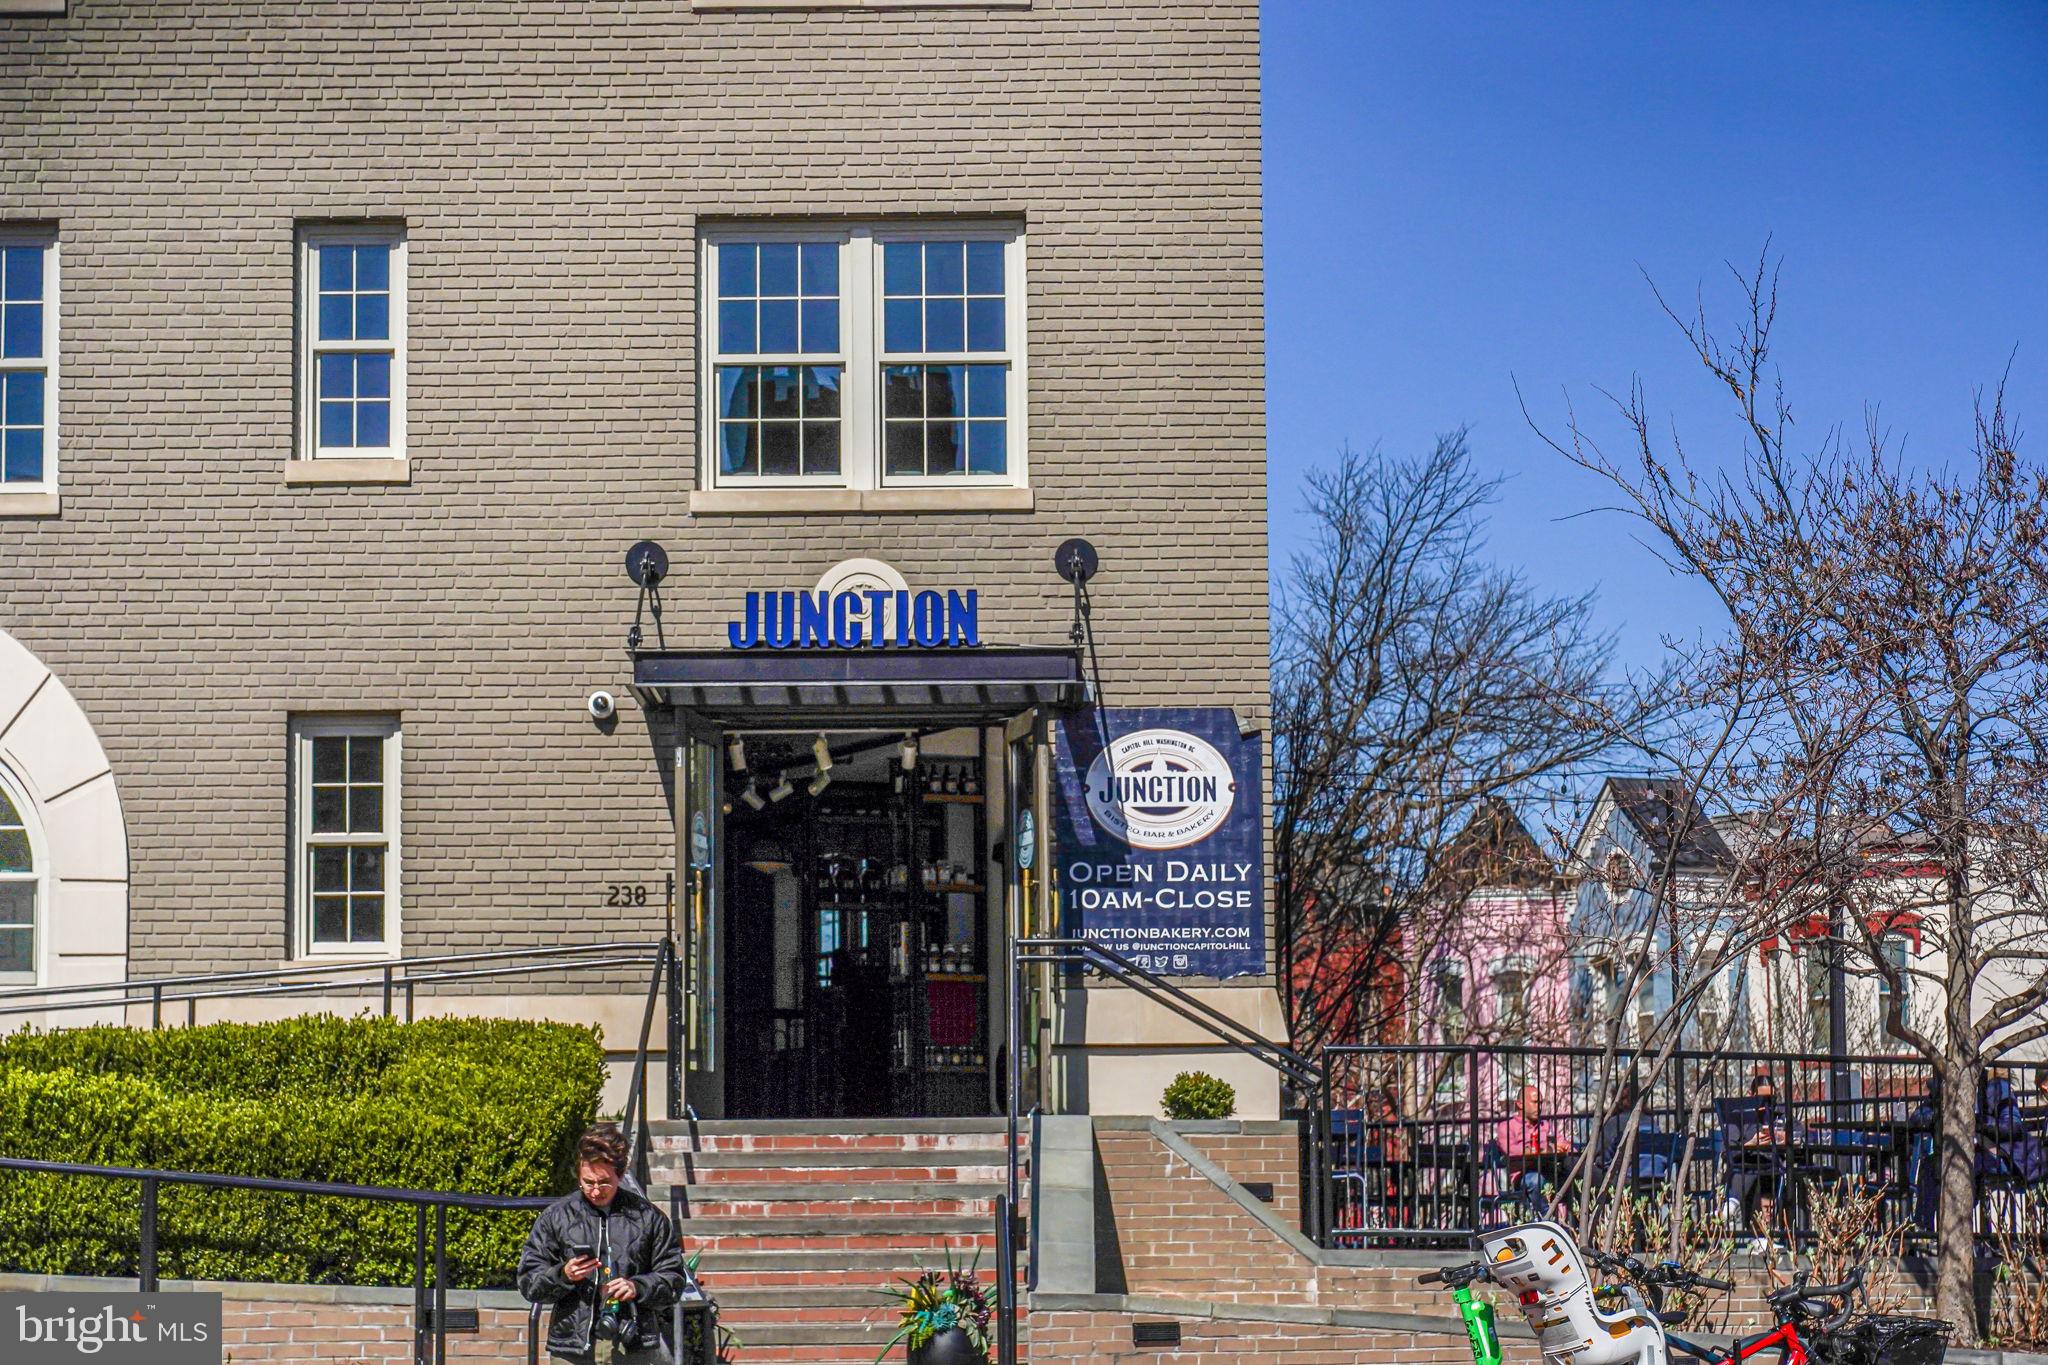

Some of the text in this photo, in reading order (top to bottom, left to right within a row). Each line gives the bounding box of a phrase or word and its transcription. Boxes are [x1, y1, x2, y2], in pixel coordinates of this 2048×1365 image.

[728, 590, 978, 649] JUNCTION
[1121, 742, 1141, 754] CAPITOL
[1156, 739, 1187, 749] WASHINGTON
[1099, 776, 1217, 802] JUNCTION
[1143, 830, 1165, 838] BAR
[1176, 809, 1215, 836] BAKERY
[1069, 861, 1252, 883] OPEN DAILY
[607, 885, 647, 907] 238
[1070, 888, 1252, 909] 10AM-CLOSE
[1115, 943, 1130, 951] US
[1132, 942, 1251, 951] @JUNCTIONCAPITOLHILL
